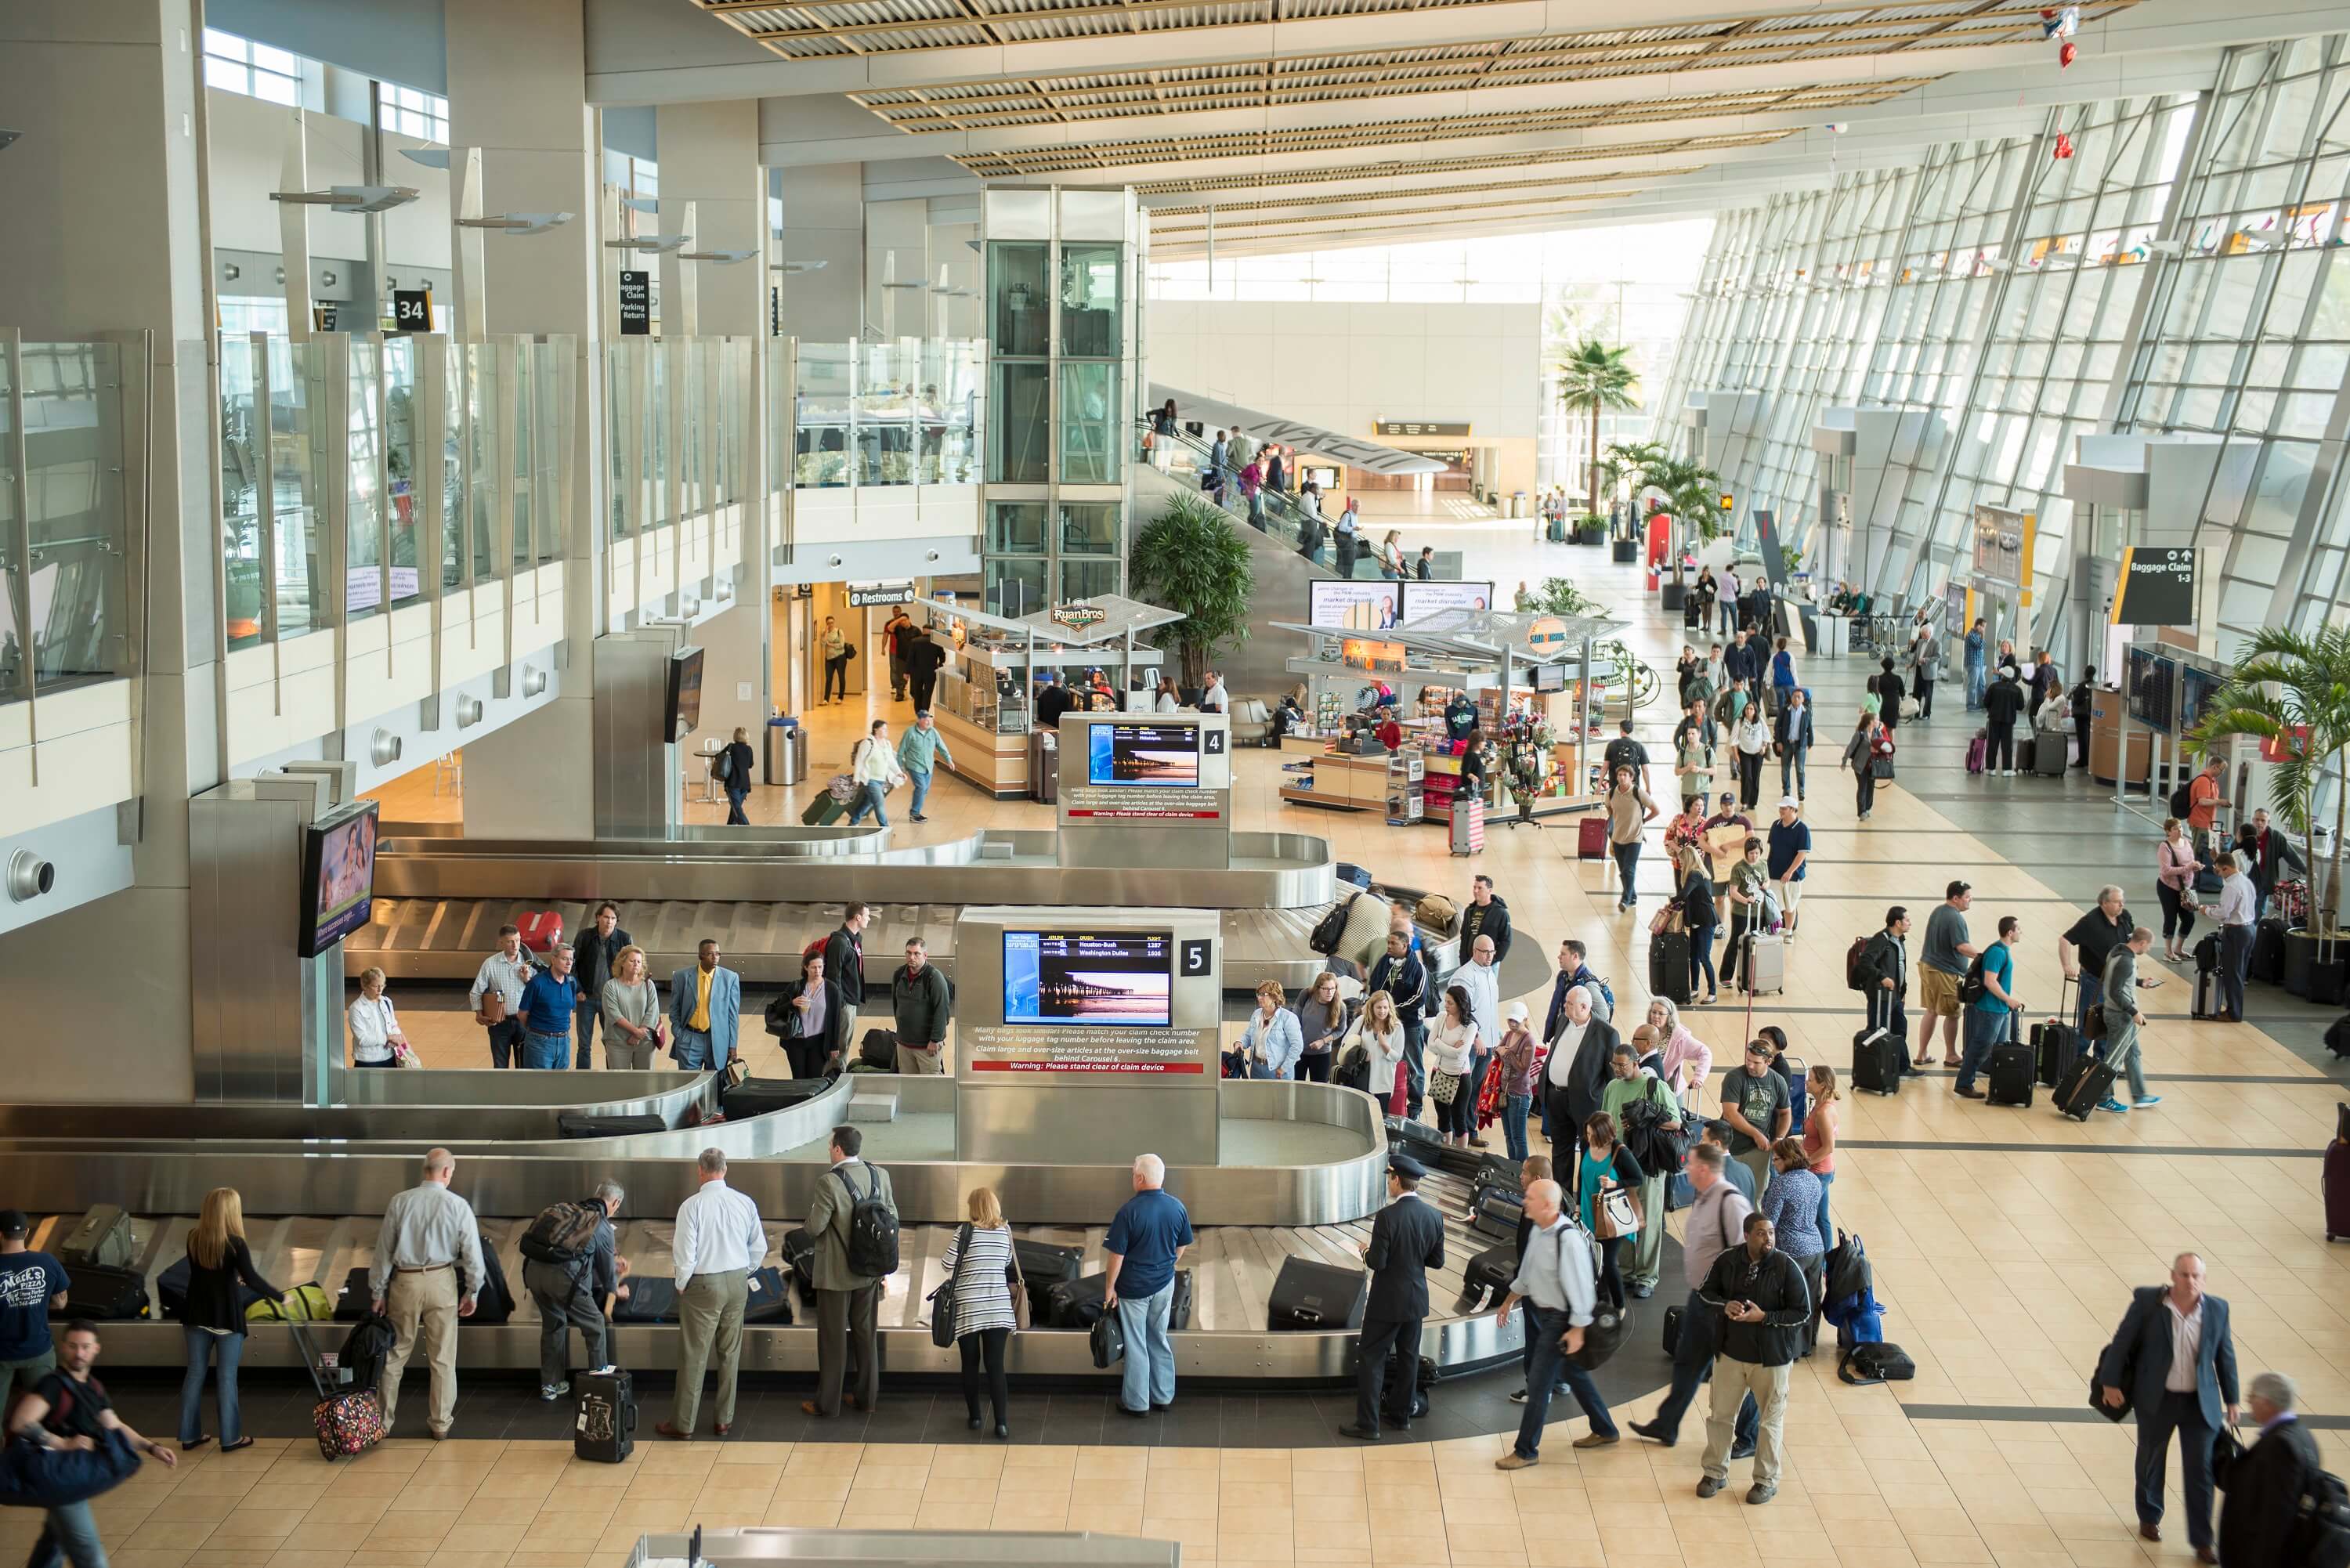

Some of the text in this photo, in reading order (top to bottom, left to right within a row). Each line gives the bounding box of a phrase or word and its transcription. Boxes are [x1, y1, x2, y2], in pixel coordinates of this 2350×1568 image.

[400, 301, 424, 320] 34
[2131, 562, 2192, 573] Baggage Claim
[2178, 573, 2191, 582] 1-3
[862, 592, 902, 603] Restrooms
[1054, 609, 1103, 620] Ryan Bros
[1209, 735, 1219, 750] 4
[1189, 948, 1202, 969] 5
[998, 1046, 1015, 1054] large
[2, 1268, 42, 1294] Mack's
[20, 1280, 41, 1289] PIZZA
